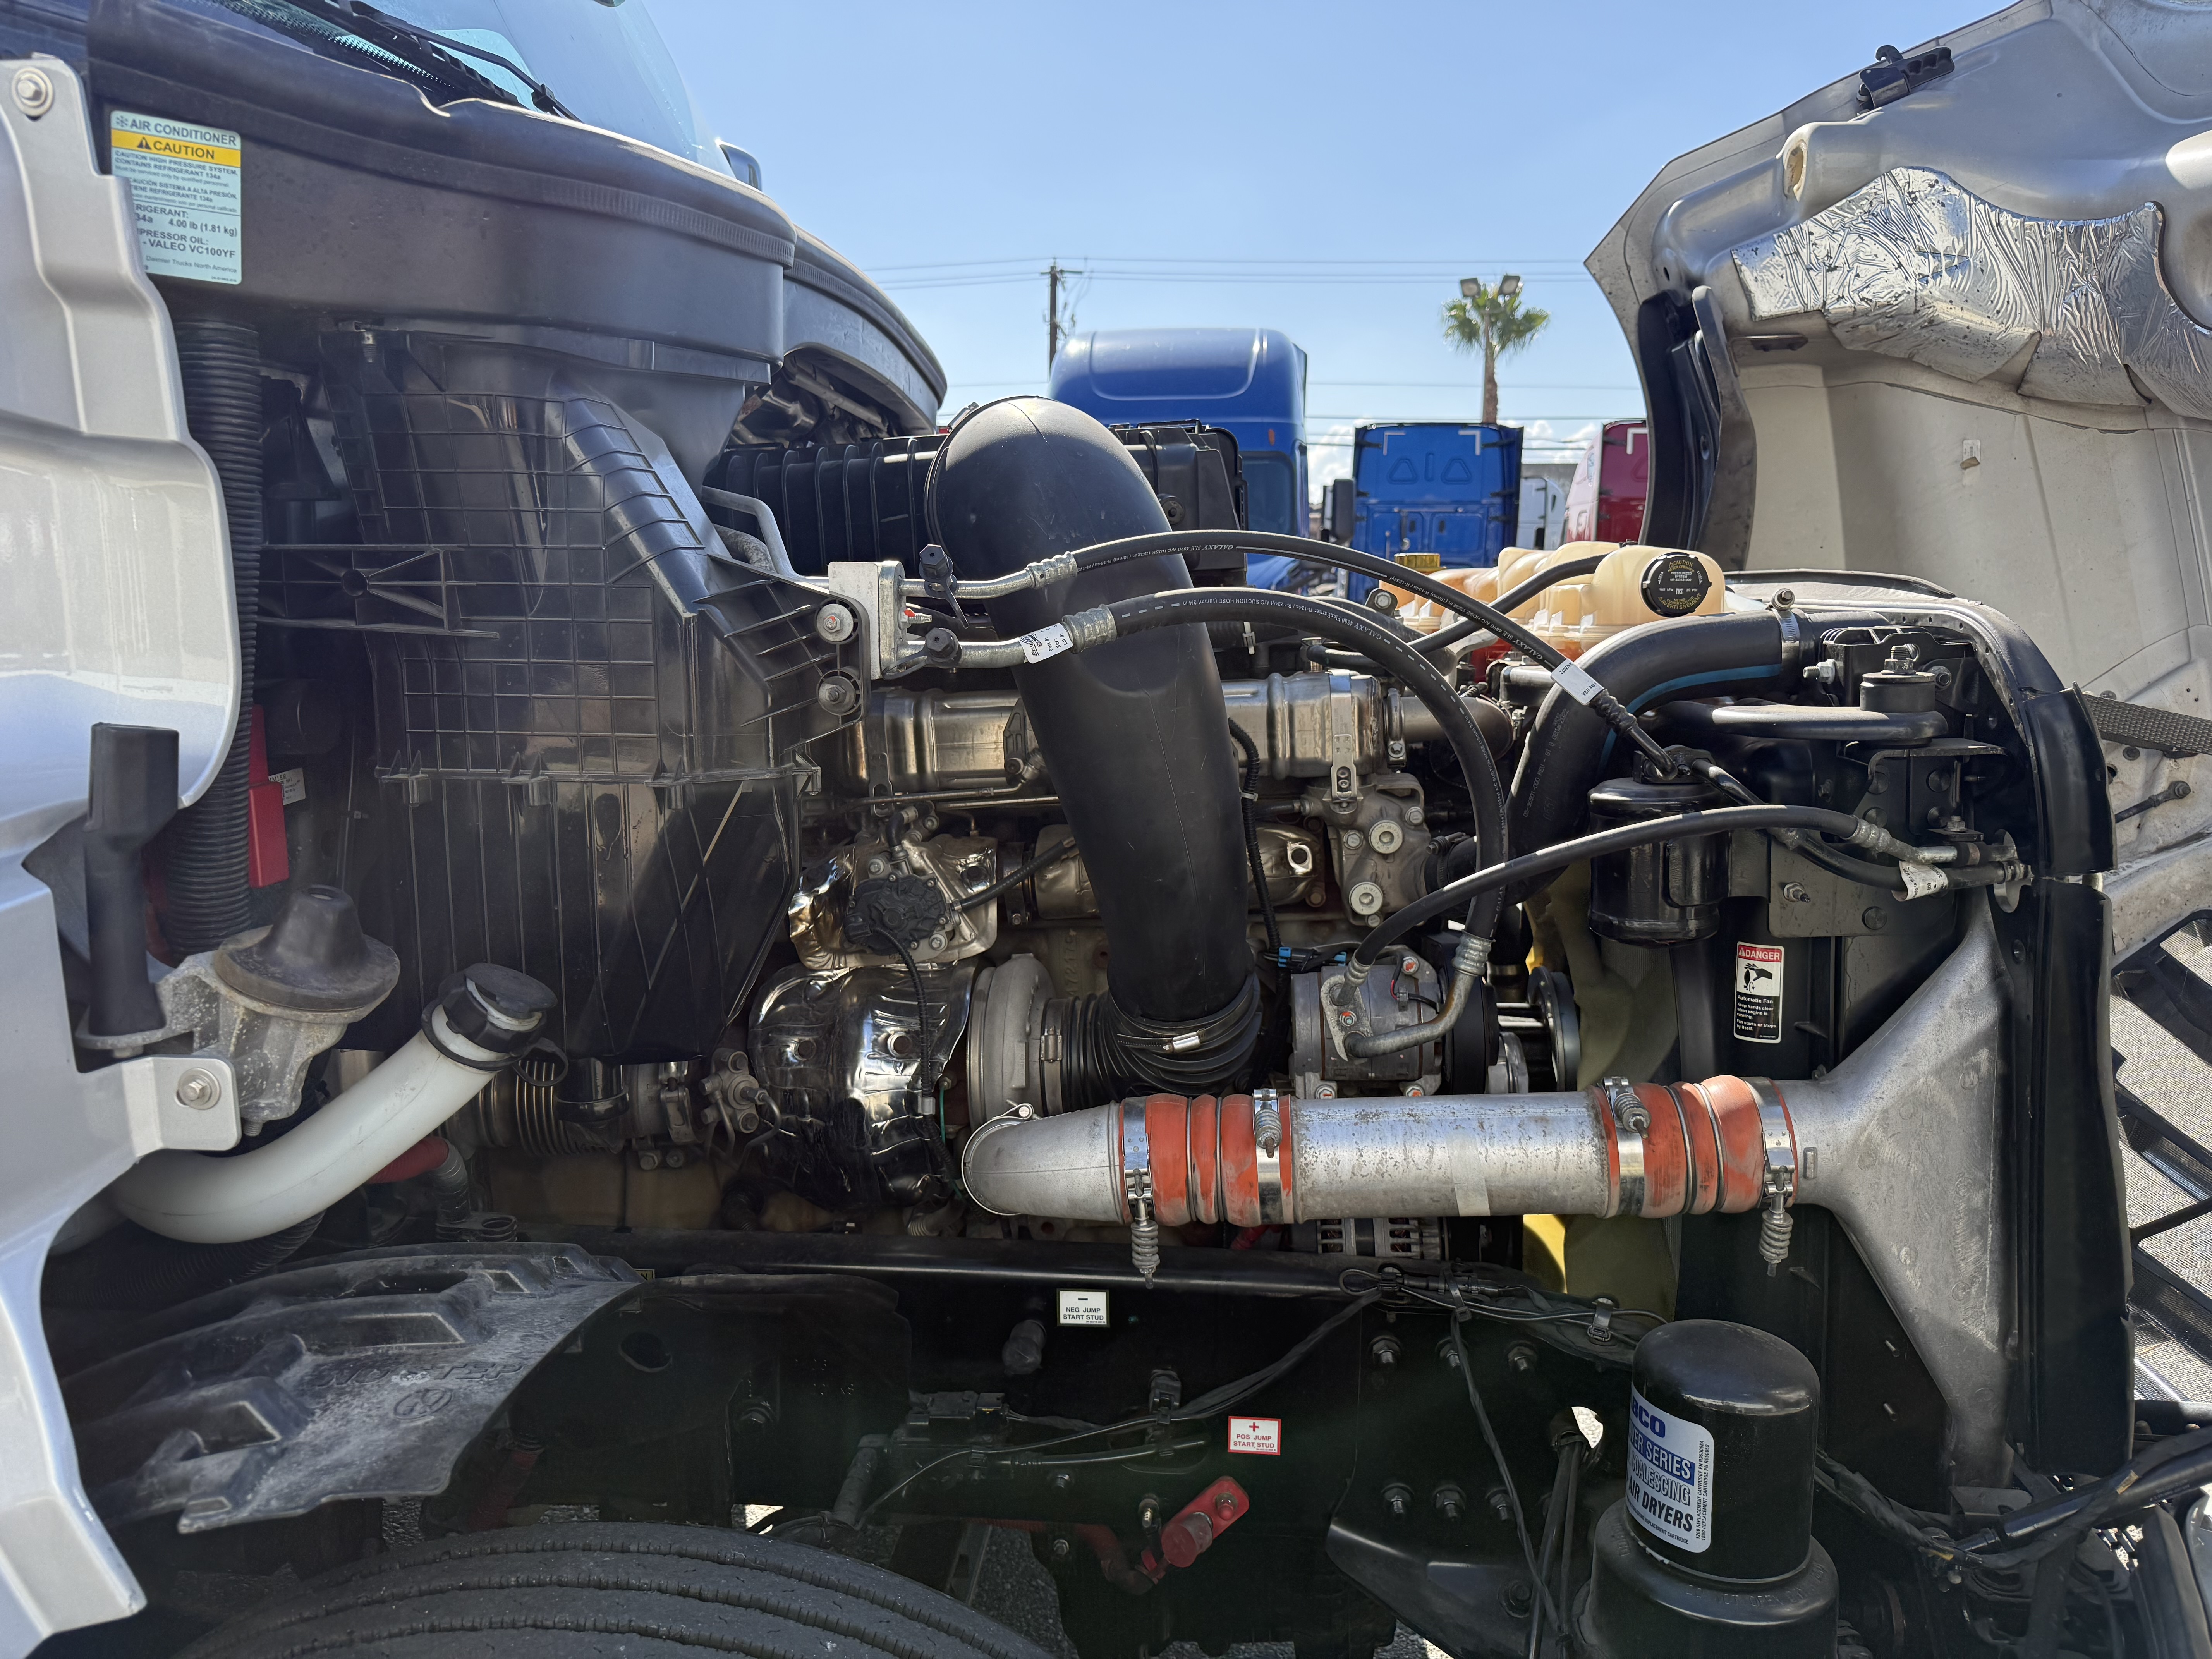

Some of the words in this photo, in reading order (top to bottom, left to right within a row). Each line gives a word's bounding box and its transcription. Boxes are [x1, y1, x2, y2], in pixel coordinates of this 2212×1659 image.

[130, 119, 151, 132] AIR
[154, 123, 236, 146] CONDITIONER
[153, 141, 215, 160] CAUTION
[115, 150, 148, 161] CAUTION
[168, 159, 207, 171] PRESSURE
[115, 157, 152, 168] CONTAINS
[153, 163, 204, 177] REFRIGERANT
[149, 187, 197, 200] REFRIGERANTE
[159, 182, 186, 191] SISTEMA
[136, 204, 189, 218] RIGERANT:
[134, 212, 153, 223] 34a
[168, 218, 187, 228] 4.00
[189, 221, 198, 230] lb
[200, 222, 221, 233] (1.81
[223, 226, 237, 237] kg)
[139, 228, 187, 242] PRESSOR
[190, 236, 209, 245] OIL:
[148, 239, 186, 252] VALEO
[189, 244, 236, 258] VC100YF
[211, 264, 237, 273] America
[1113, 554, 1131, 563] (10mm)
[1413, 585, 1430, 595] R-134a
[1271, 600, 1292, 609] R-1234yf
[1430, 592, 1448, 603] (10mm)
[1296, 605, 1312, 613] R-134a
[1314, 608, 1341, 622] FlexBarrier
[1453, 603, 1466, 613] 13/32
[1466, 610, 1481, 620] HOSE
[1341, 617, 1353, 626] 4880
[1481, 618, 1491, 626] A/C
[1354, 623, 1382, 639] GALAXY
[1502, 630, 1514, 640] SLE
[1513, 639, 1543, 660] GALAXY
[1581, 688, 1591, 696] USA
[1480, 744, 1488, 760] HOSE
[1486, 759, 1497, 782] SUCTION
[1496, 885, 1504, 912] GALAX
[1745, 949, 1781, 960] DANGER
[1738, 994, 1762, 1003] Automatic
[1631, 1395, 1665, 1438] BCO
[1646, 1441, 1691, 1479] SERIES
[1632, 1451, 1690, 1506] COALESCING
[1628, 1475, 1640, 1503] AIR
[1642, 1491, 1693, 1532] DRYERS
[1644, 1518, 1667, 1535] REPLACEMENT
[1667, 1531, 1688, 1544] CARTRIDGE
